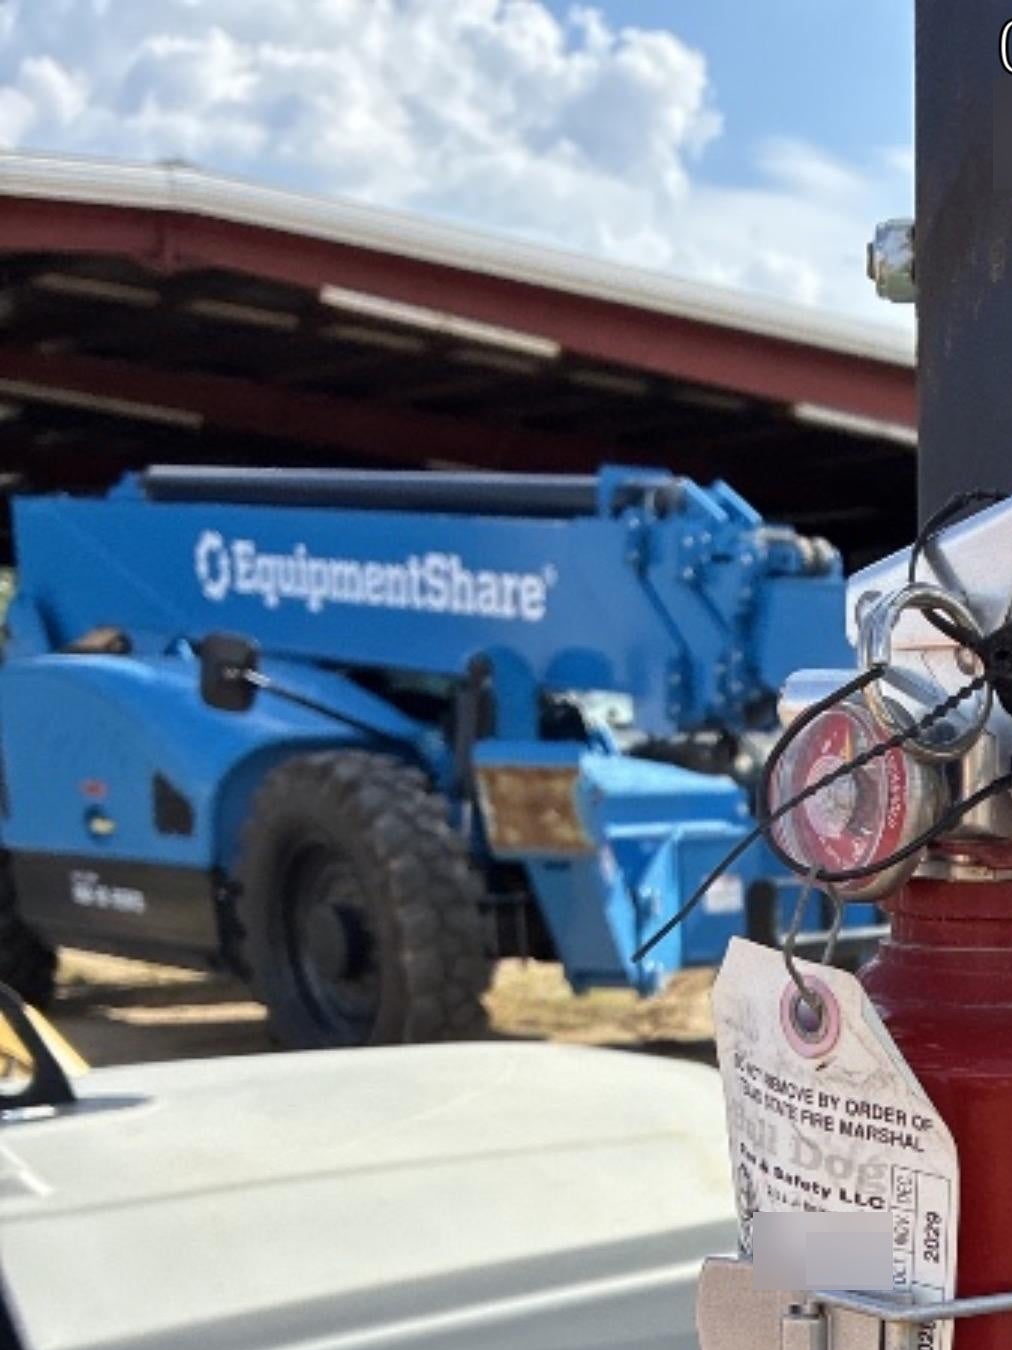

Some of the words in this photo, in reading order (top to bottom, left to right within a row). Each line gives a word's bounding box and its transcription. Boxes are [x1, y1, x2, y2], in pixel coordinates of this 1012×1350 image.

[764, 1073, 814, 1106] REMOVE
[817, 1090, 841, 1113] BY
[845, 1099, 907, 1126] ORDER
[911, 1114, 934, 1132] OF
[800, 1109, 835, 1133] FIRE
[838, 1120, 925, 1153] MARSHAL
[773, 1166, 833, 1200] Safety
[839, 1186, 885, 1211] LLC
[790, 1134, 889, 1196] Dog
[923, 1210, 942, 1265] 2029
